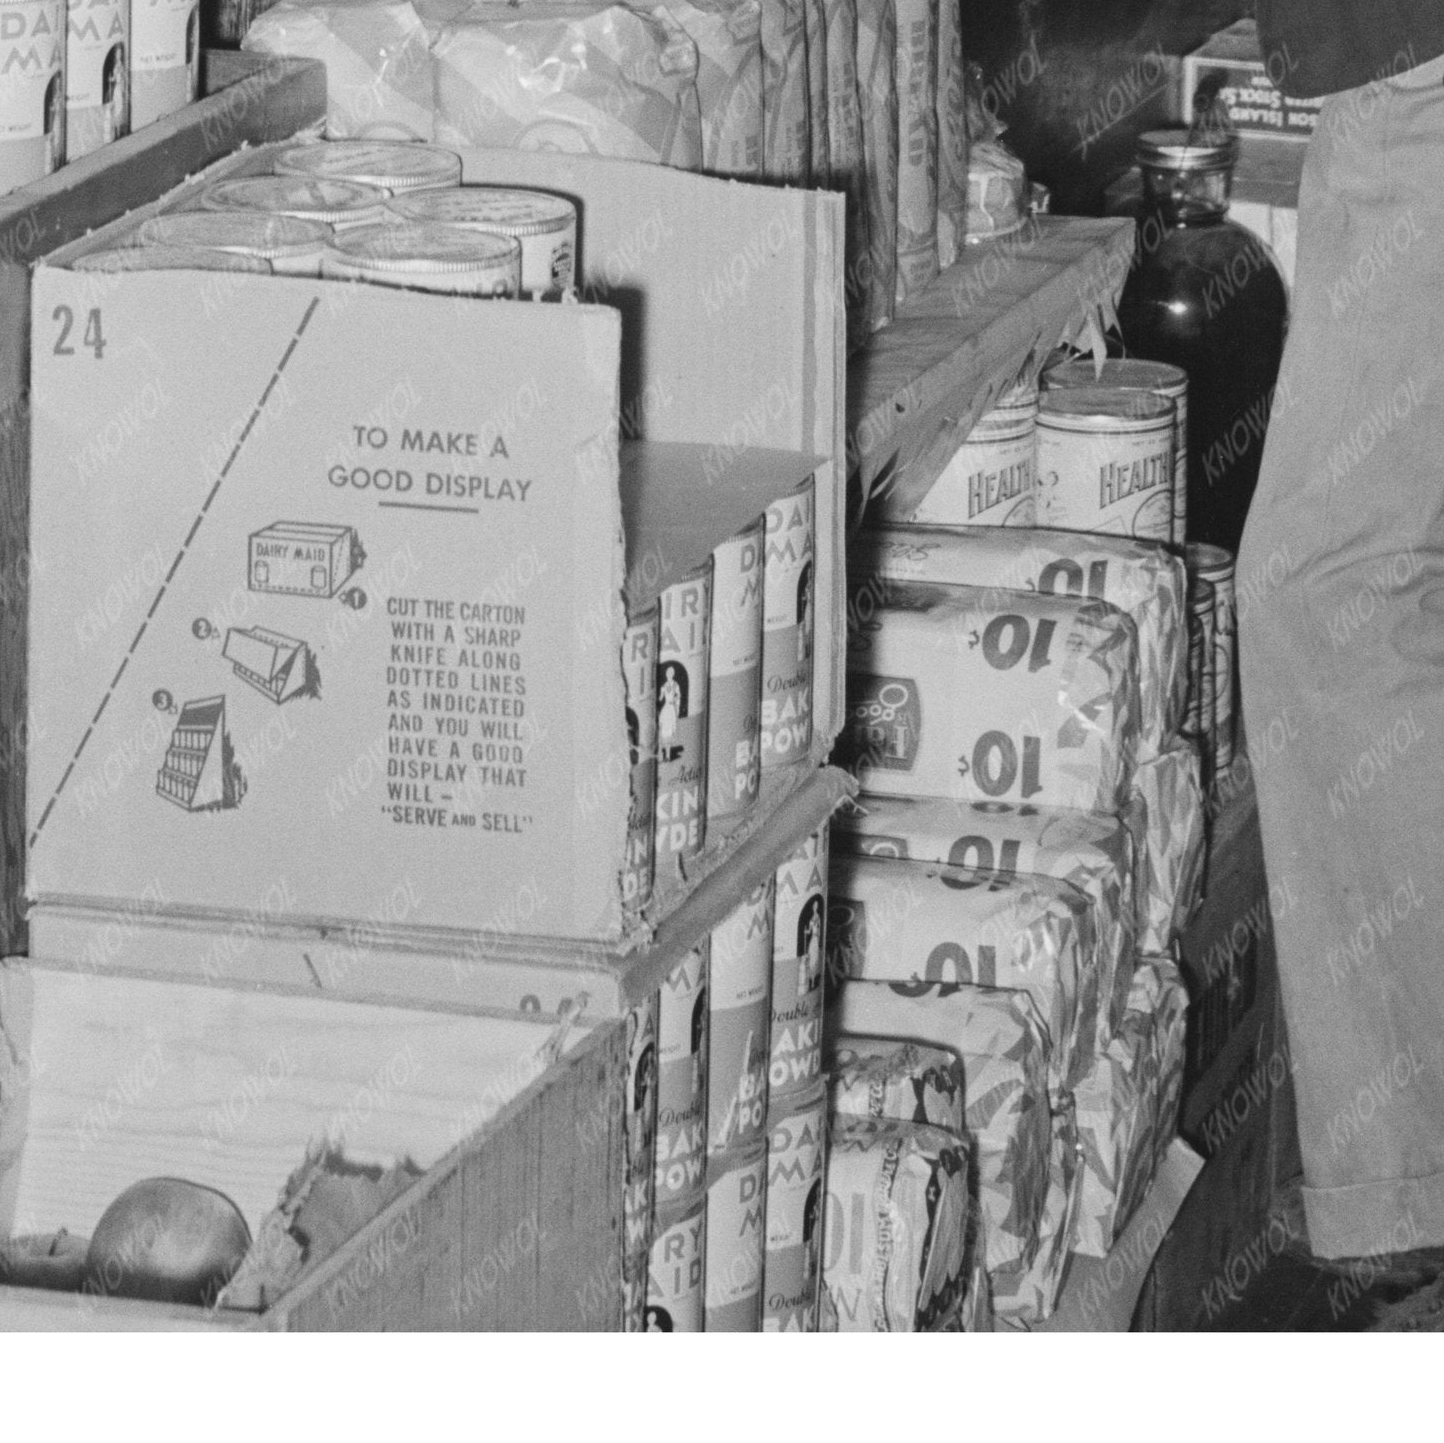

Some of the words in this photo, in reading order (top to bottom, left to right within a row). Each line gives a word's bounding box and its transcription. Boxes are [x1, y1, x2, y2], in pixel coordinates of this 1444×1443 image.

[1238, 88, 1282, 109] STOCK
[1228, 106, 1284, 128] ISLAND
[52, 304, 107, 360] 24
[353, 424, 388, 450] TO
[400, 427, 479, 458] MAKE
[488, 434, 510, 460] A
[327, 464, 413, 493] GOOD
[425, 471, 533, 502] DISPLAY
[1099, 450, 1173, 510] HEALTH
[256, 542, 289, 561] DAIRY
[293, 543, 327, 563] MAID
[387, 596, 419, 617] CUT
[424, 599, 455, 621] THE
[459, 601, 526, 625] CARTON
[391, 621, 435, 642] WITH
[444, 624, 455, 644] A
[464, 626, 521, 648] SHARP
[390, 644, 447, 666] KNIFE
[458, 648, 521, 671] ALONG
[386, 665, 459, 690] DOTTED
[471, 672, 527, 696] LINES
[387, 689, 411, 710] AS
[422, 691, 525, 718] INDICATED
[388, 712, 423, 733] AND
[435, 716, 469, 737] YOU
[480, 720, 524, 741] WILL
[388, 735, 438, 758] HAVE
[449, 740, 461, 759] A
[472, 742, 524, 765] GOOD
[387, 758, 467, 784] DISPLAY
[479, 765, 527, 788] THAT
[387, 781, 433, 804] WILL
[451, 812, 477, 827] AND
